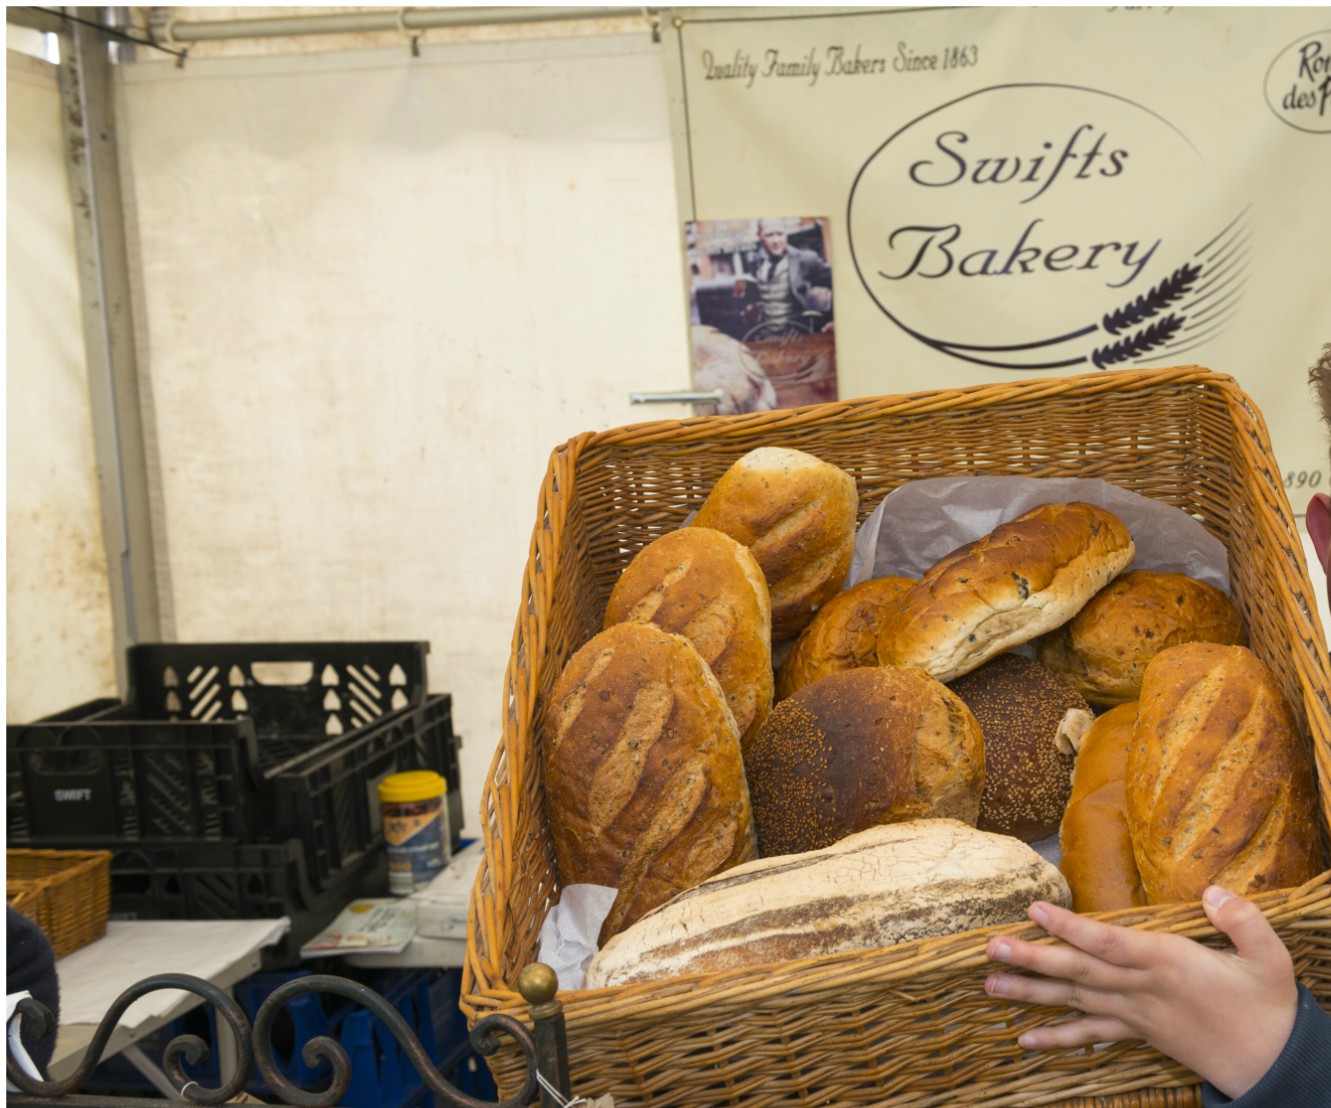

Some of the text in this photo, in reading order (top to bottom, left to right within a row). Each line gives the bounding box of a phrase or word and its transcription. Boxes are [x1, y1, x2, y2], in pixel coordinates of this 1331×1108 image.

[702, 41, 978, 88] Quality Family Bakers Since 1863
[1283, 85, 1315, 110] des
[909, 124, 1129, 204] Swifts
[878, 219, 1163, 288] Bakery
[54, 789, 92, 801] SWIFT
